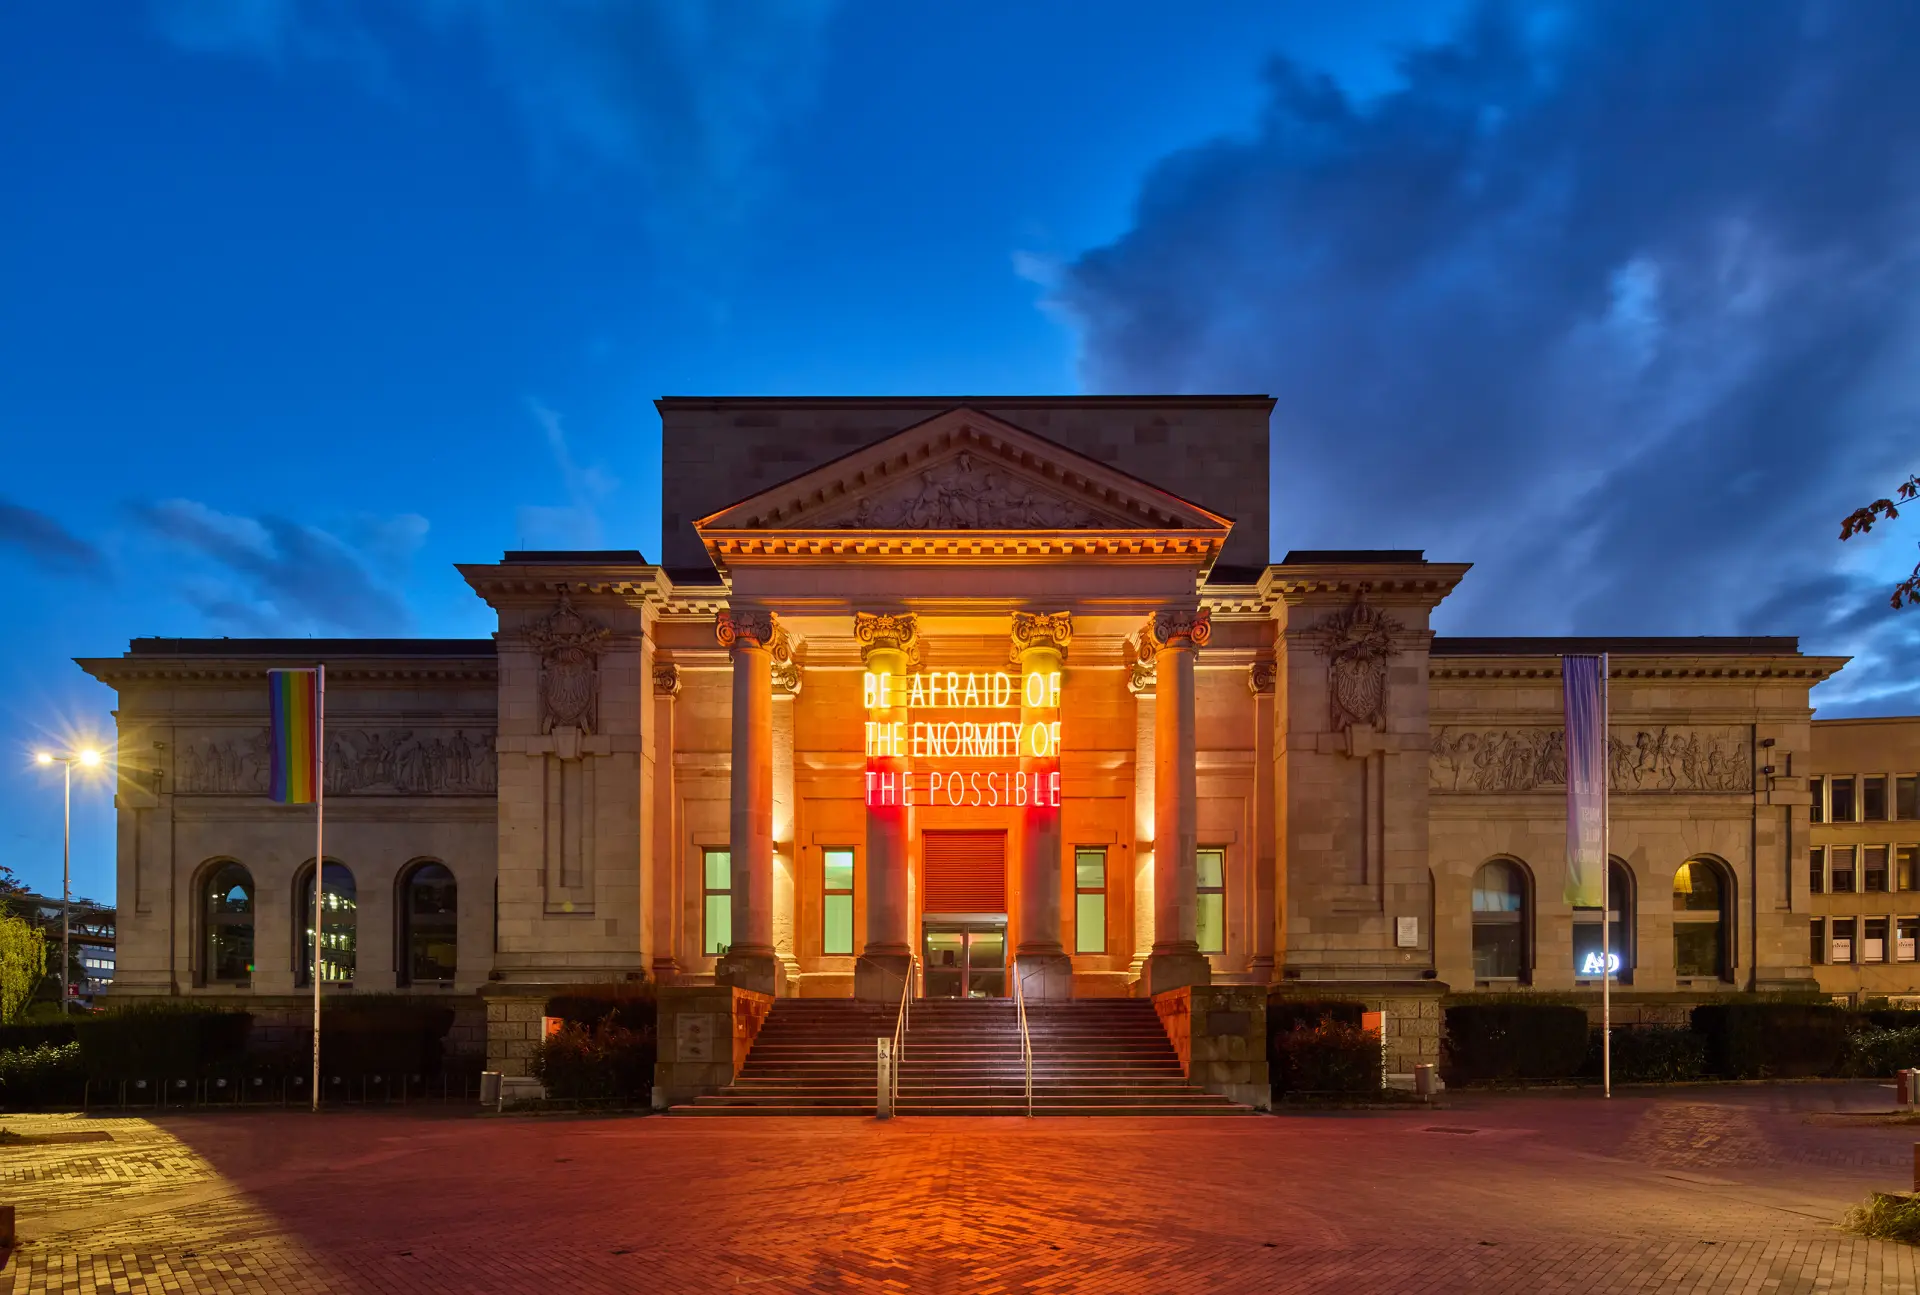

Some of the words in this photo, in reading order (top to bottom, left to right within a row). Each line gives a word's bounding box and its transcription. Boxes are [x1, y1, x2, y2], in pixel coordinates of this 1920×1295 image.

[863, 672, 892, 709] BE
[910, 672, 1011, 709] AFRAID
[1026, 672, 1061, 709] OF
[864, 722, 905, 757] THE
[913, 721, 1023, 758] ENORMITY
[1031, 721, 1062, 758] OF
[865, 771, 913, 807] THE
[929, 771, 1061, 807] POSSIBLE
